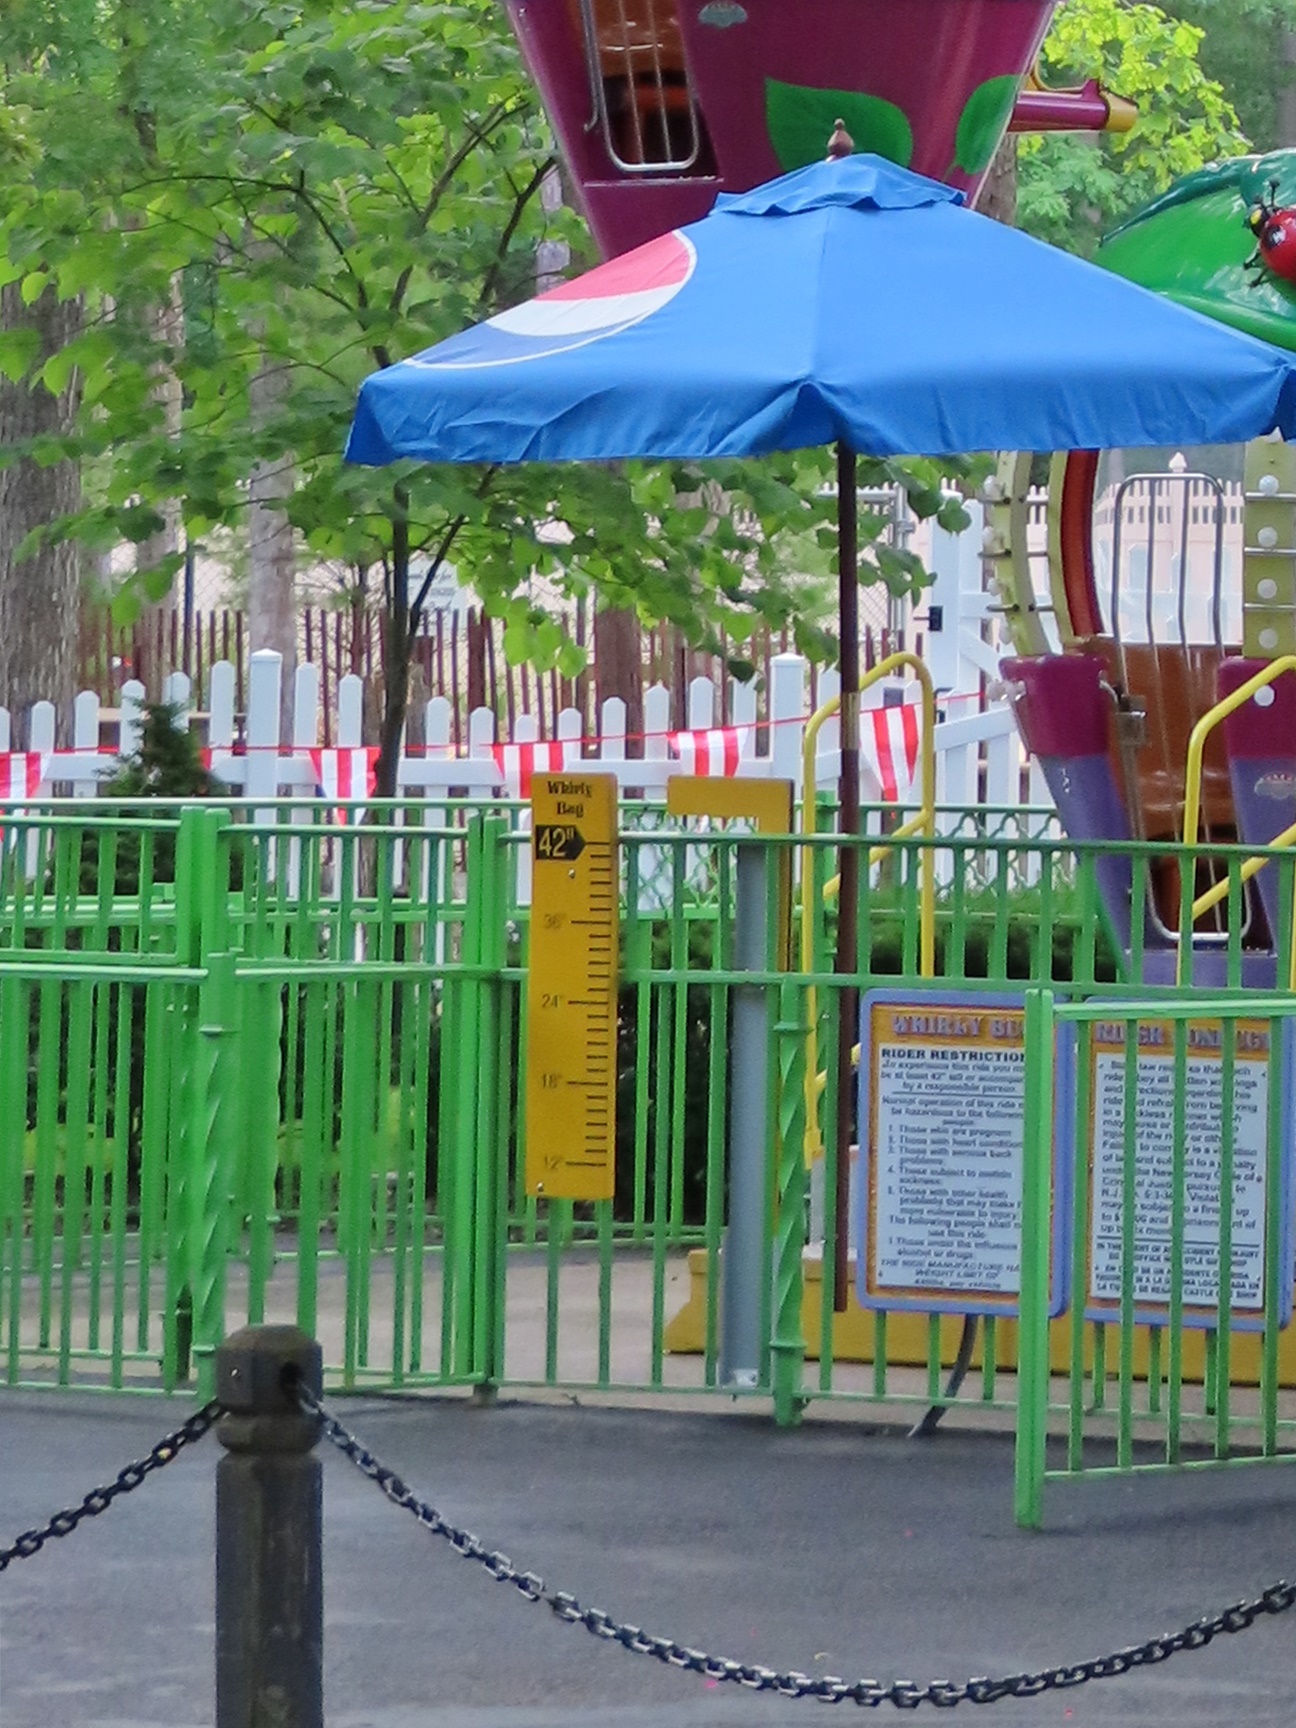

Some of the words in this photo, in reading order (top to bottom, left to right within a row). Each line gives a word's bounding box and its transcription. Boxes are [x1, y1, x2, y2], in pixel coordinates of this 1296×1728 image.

[547, 780, 592, 798] Whirly
[557, 801, 584, 818] Bug
[538, 827, 575, 857] 42"
[893, 1015, 984, 1036] WHIRLY
[990, 1018, 1025, 1040] BU
[881, 1048, 926, 1059] RIDER
[930, 1050, 1025, 1062] RESTRICTIO
